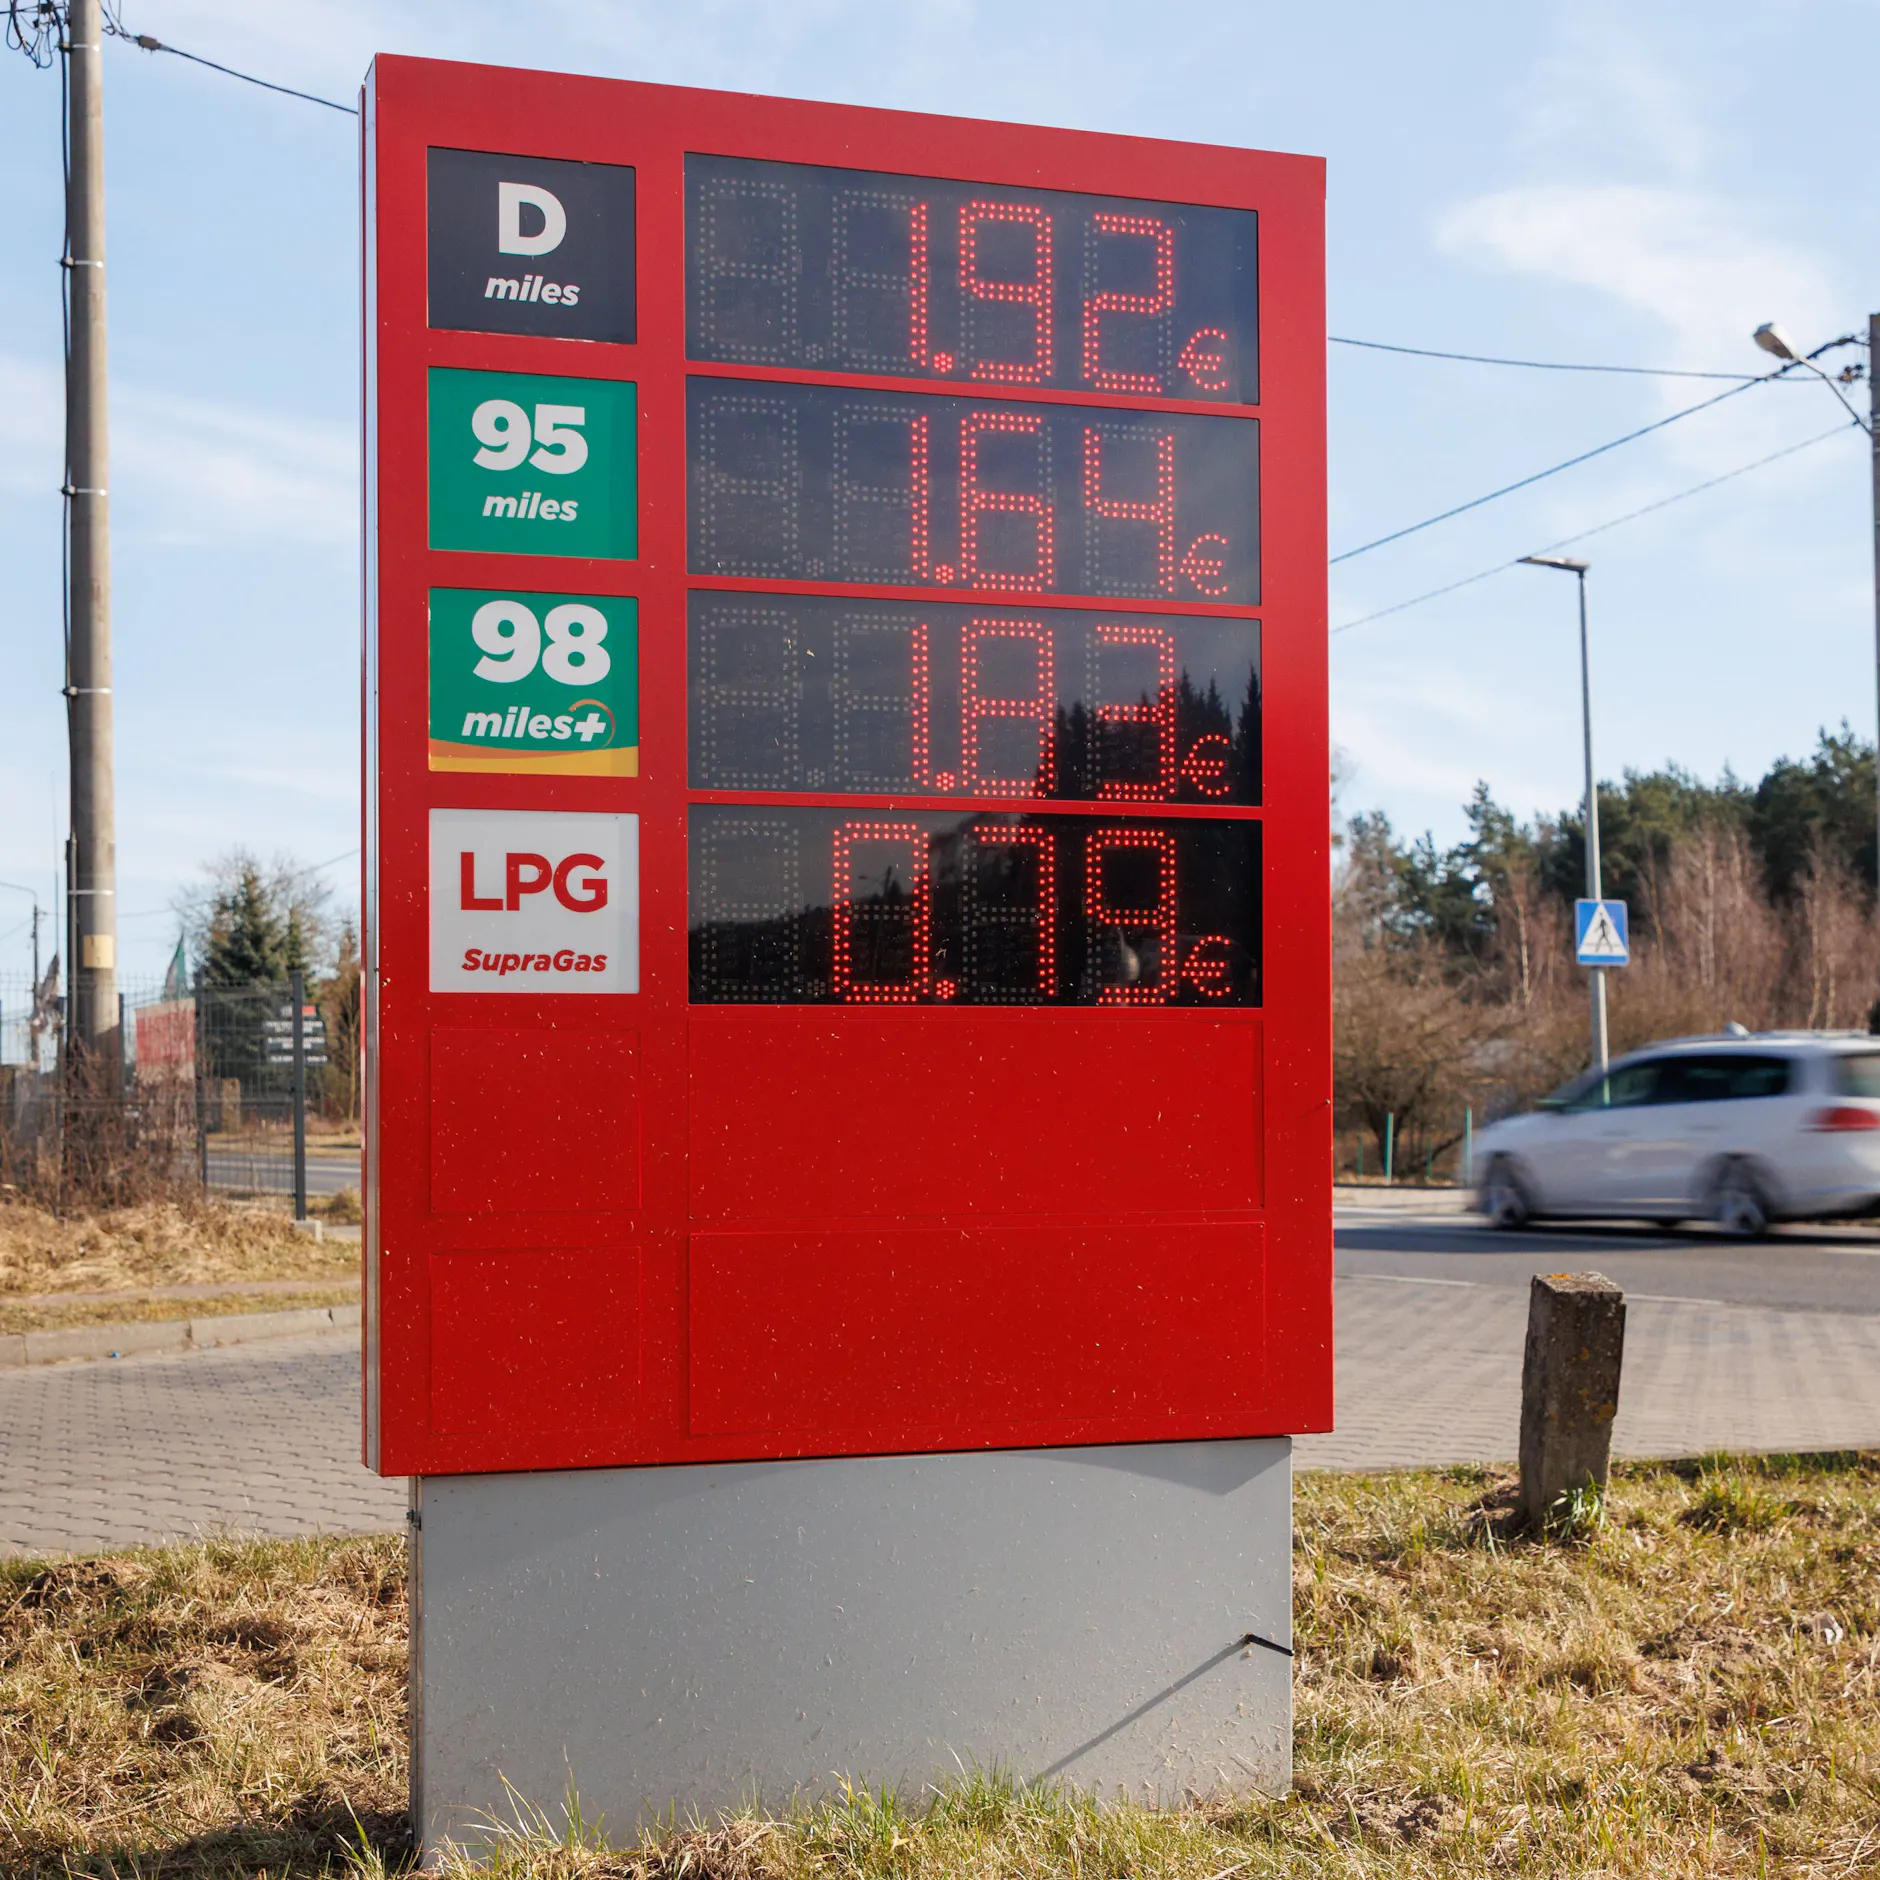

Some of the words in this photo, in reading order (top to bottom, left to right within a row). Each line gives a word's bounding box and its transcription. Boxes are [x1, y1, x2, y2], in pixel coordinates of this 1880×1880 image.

[498, 182, 567, 256] D
[484, 273, 580, 307] miles
[471, 399, 589, 474] 95
[481, 490, 579, 522] miles
[471, 599, 611, 686] 98
[460, 851, 608, 913] LPG
[461, 948, 608, 976] SupraGas
